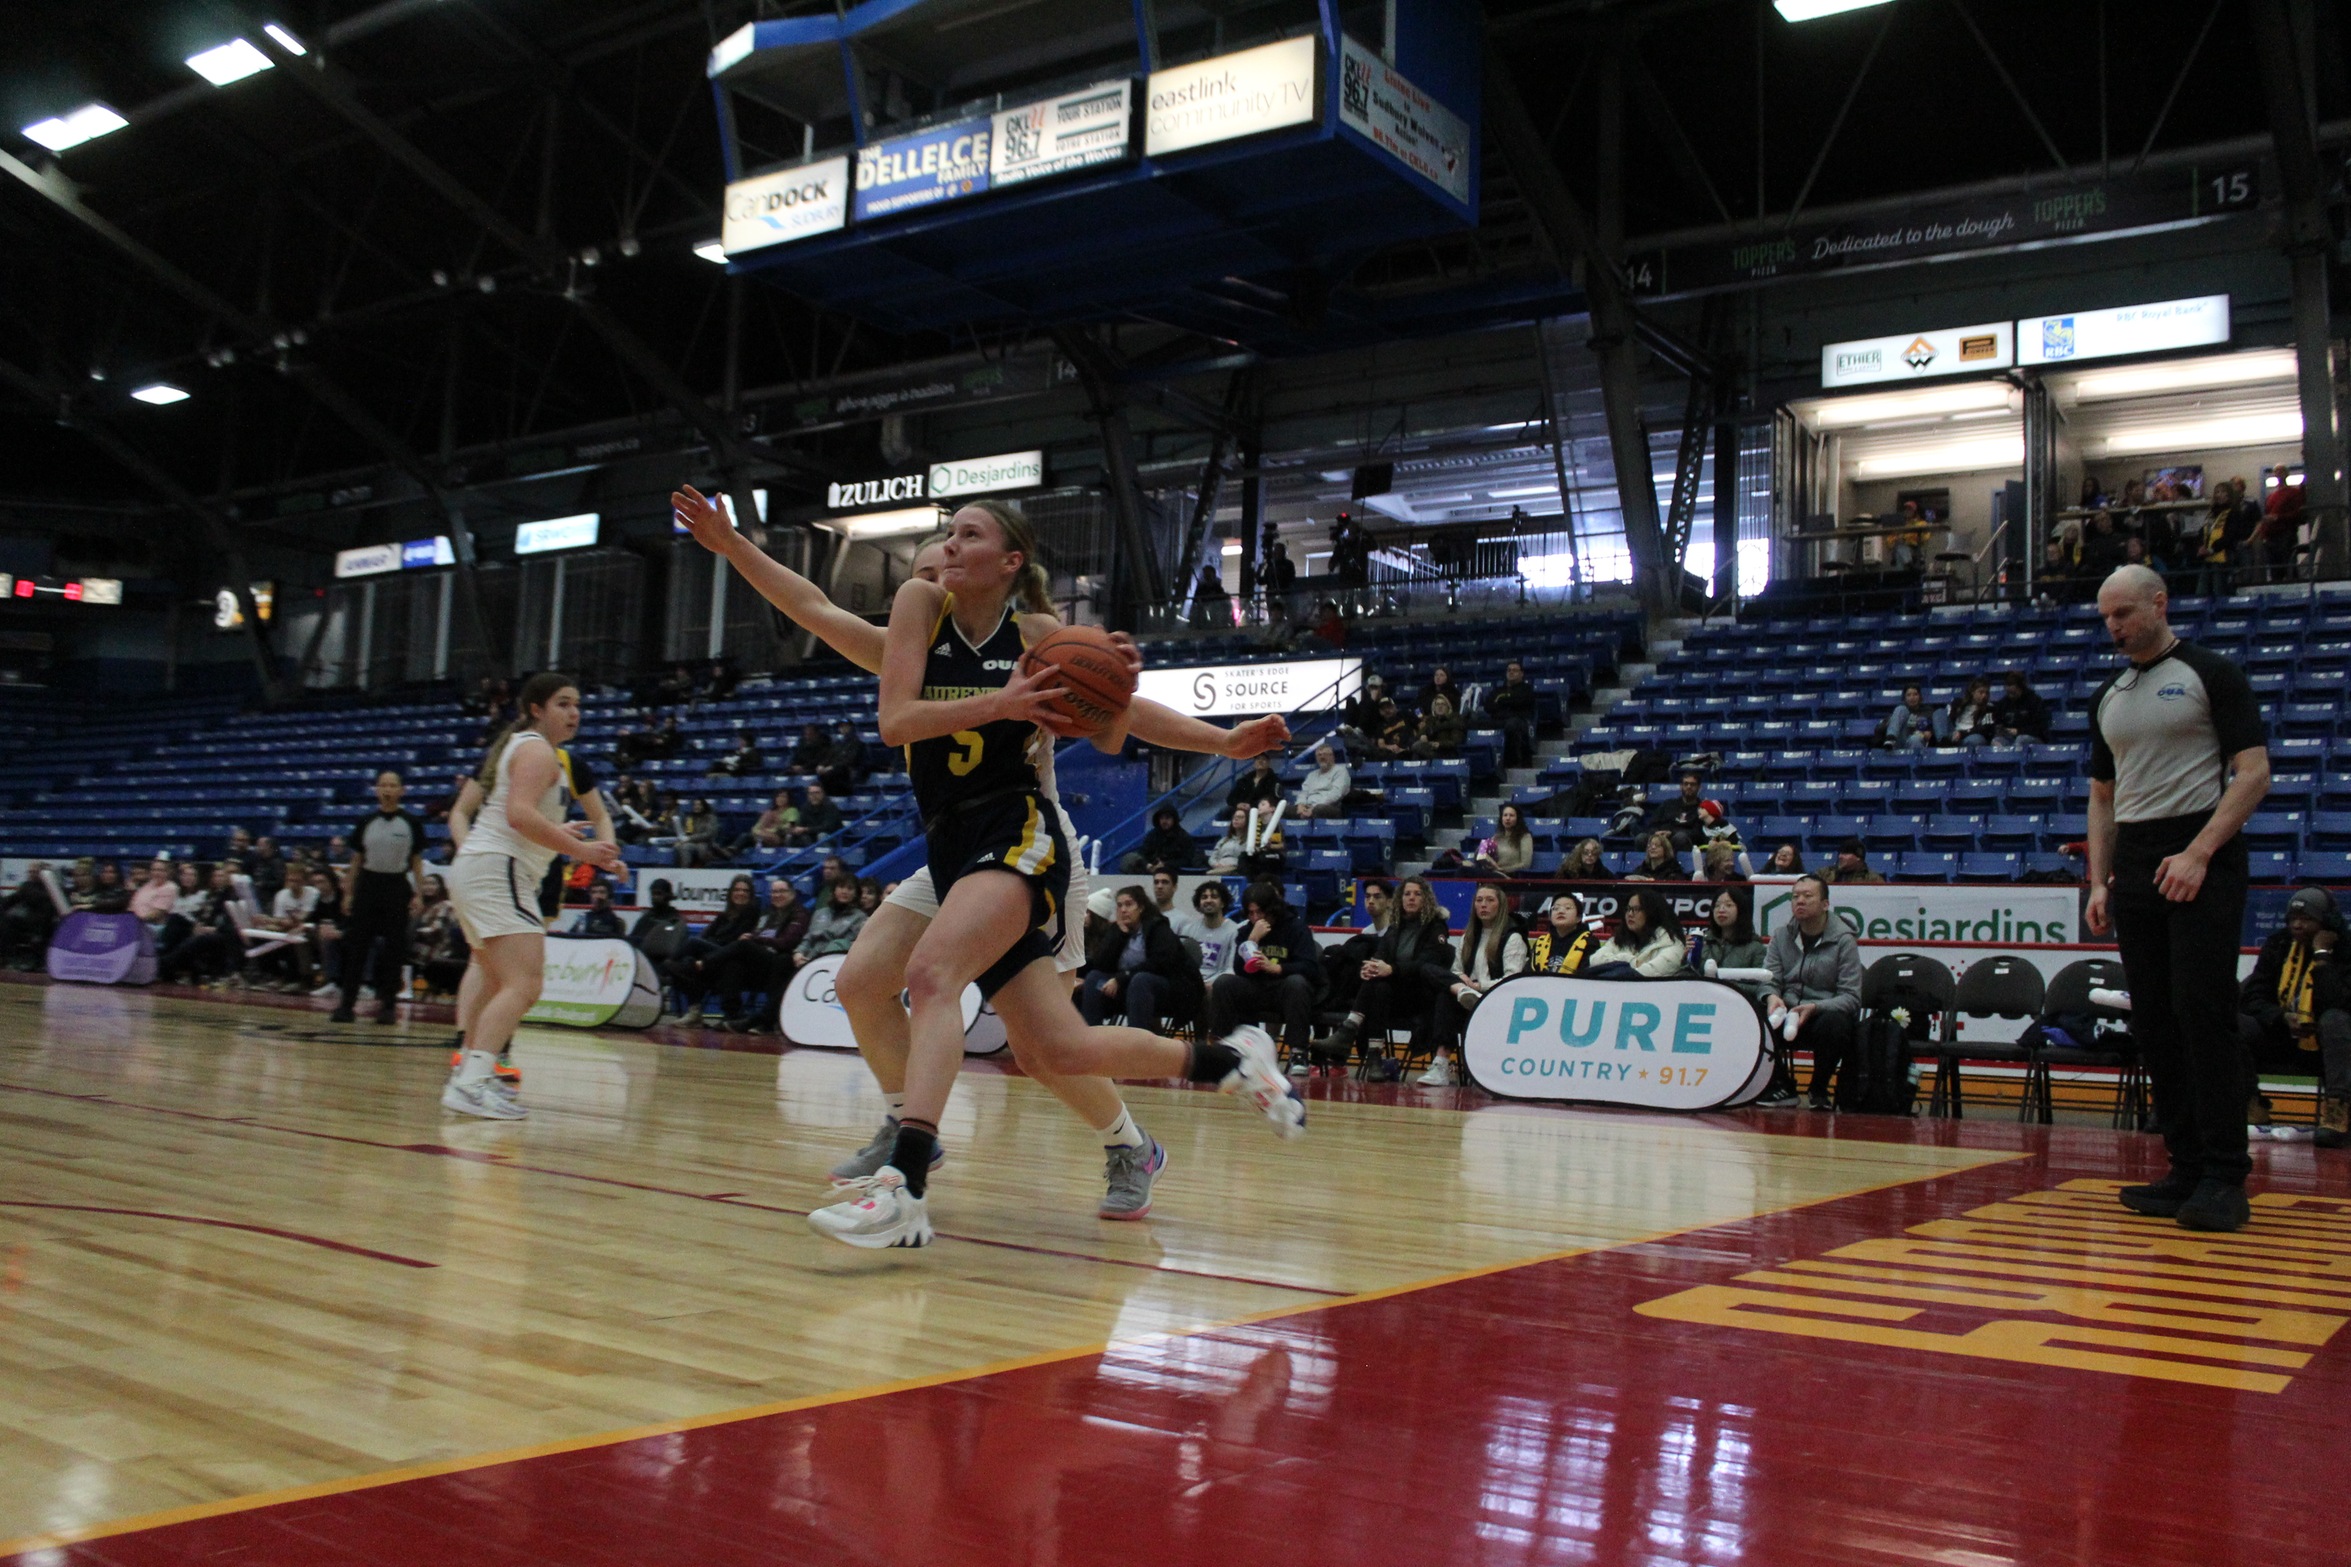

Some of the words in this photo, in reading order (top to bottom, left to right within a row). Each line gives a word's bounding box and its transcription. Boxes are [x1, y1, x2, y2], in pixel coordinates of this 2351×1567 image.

[1152, 71, 1237, 111] eastlink
[1344, 72, 1369, 110] 96.7
[1084, 96, 1121, 117] STATION
[1151, 92, 1275, 136] community
[1280, 78, 1308, 105] TV
[1373, 91, 1407, 128] Sudbury
[1005, 130, 1041, 162] 96.7
[856, 132, 989, 191] DELLELCE
[938, 162, 987, 185] FAMILY
[2211, 172, 2249, 204] 15
[1811, 228, 1902, 259] Dedicated
[1906, 230, 1922, 245] to
[1925, 223, 1952, 241] the
[1956, 212, 2014, 237] dough
[1625, 263, 1653, 290] 14
[1839, 352, 1880, 369] ETHIER
[2045, 346, 2072, 358] RBC
[957, 461, 1040, 487] Desjardins
[841, 475, 924, 507] ZULICH
[982, 660, 1018, 671] OU
[1225, 668, 1264, 678] SKATER'S
[1267, 667, 1289, 676] EDGE
[1226, 681, 1288, 697] SOURCE
[1230, 702, 1247, 711] FOR
[1250, 700, 1282, 710] SPORTS
[1537, 897, 1618, 916] ATO
[1833, 906, 2067, 943] Desjardins
[1506, 997, 1717, 1055] PURE
[1501, 1057, 1632, 1081] COUNTRY
[1659, 1066, 1708, 1087] 91.7
